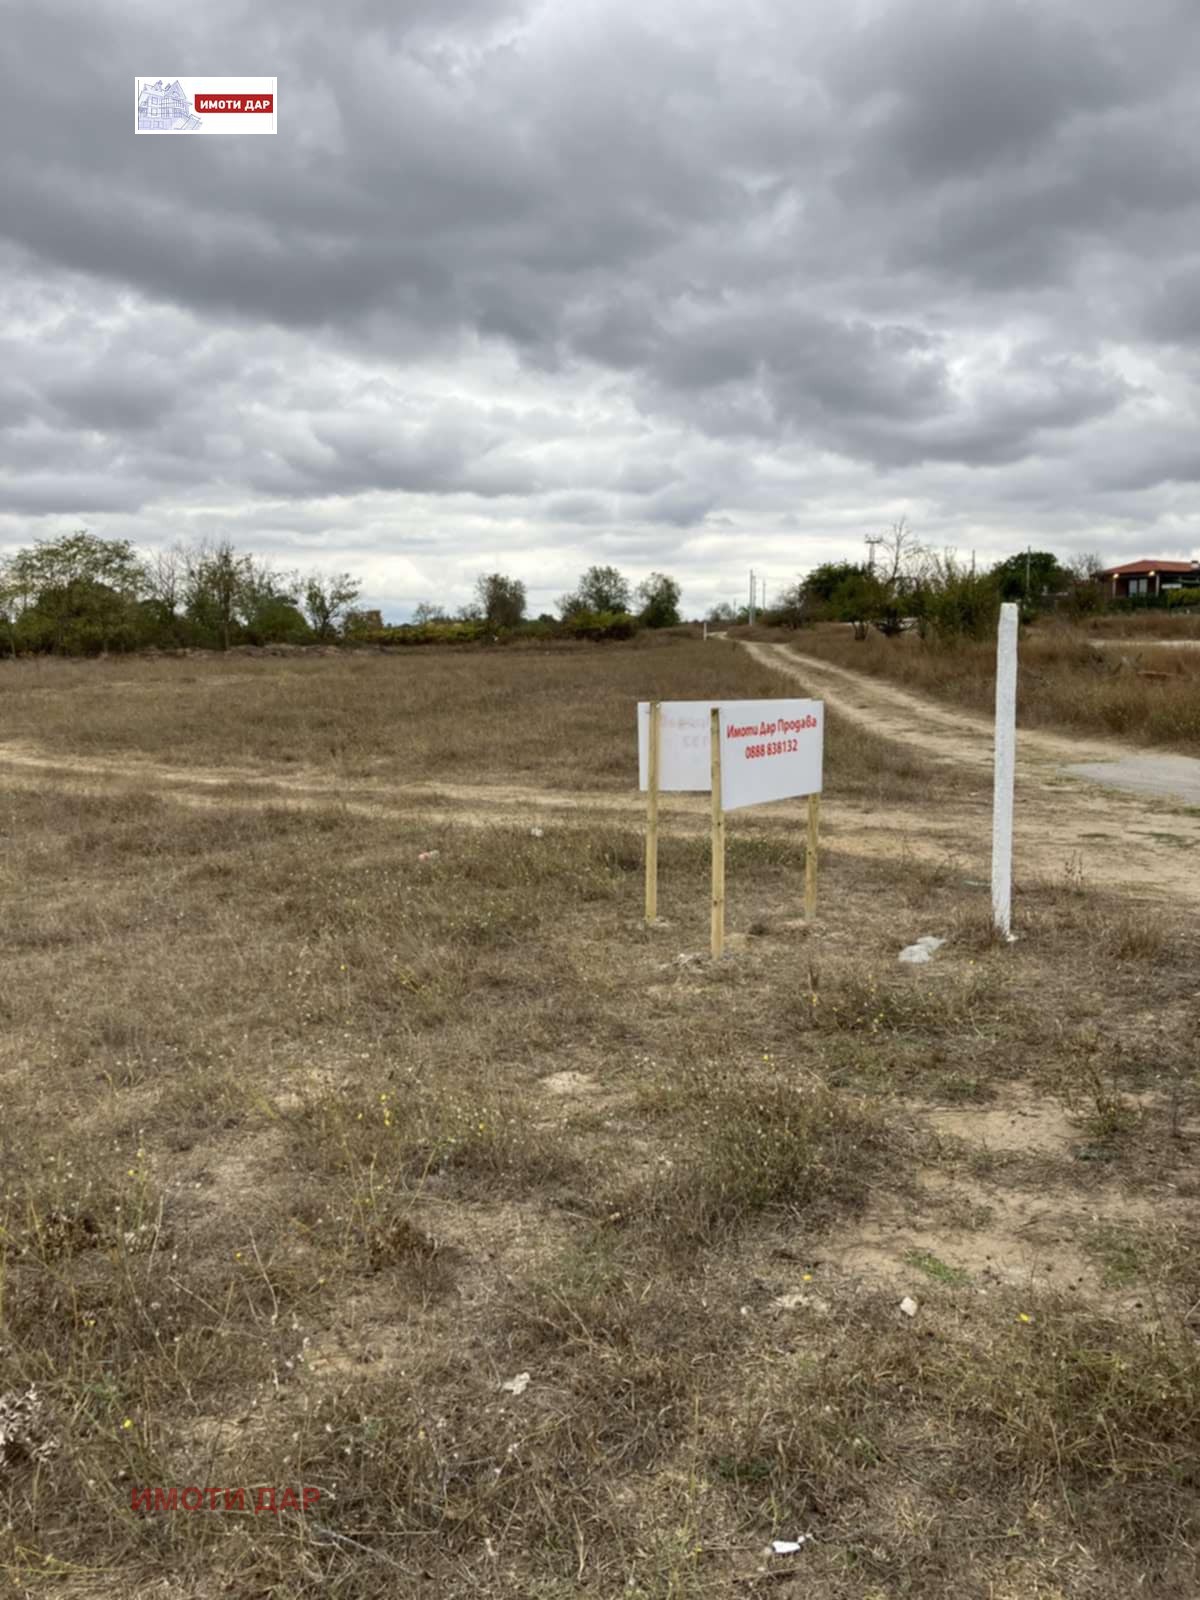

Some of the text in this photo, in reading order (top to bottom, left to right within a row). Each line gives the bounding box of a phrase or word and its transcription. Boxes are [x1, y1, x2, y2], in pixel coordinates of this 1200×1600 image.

[727, 715, 817, 739] Имоти Дар Продава
[745, 745, 765, 759] 0888
